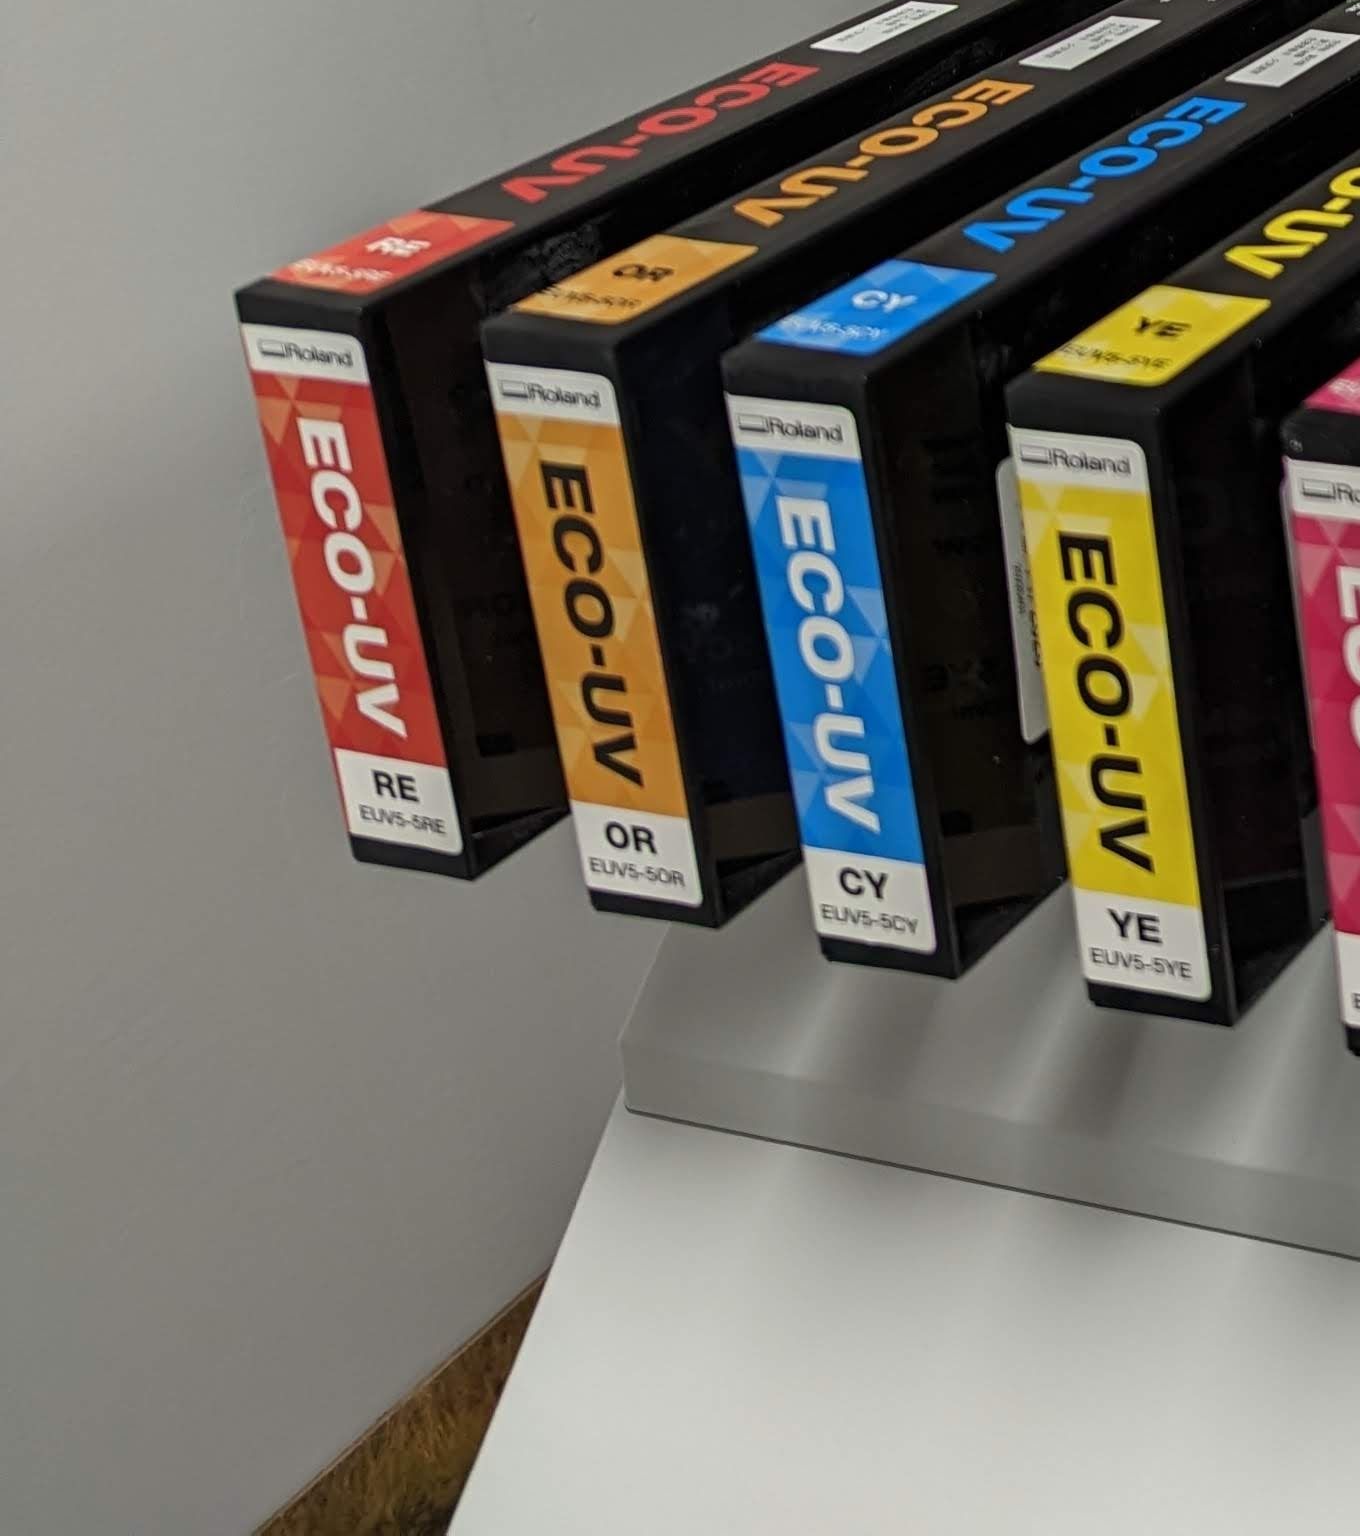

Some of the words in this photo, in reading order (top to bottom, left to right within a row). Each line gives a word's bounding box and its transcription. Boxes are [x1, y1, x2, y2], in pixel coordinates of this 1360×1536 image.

[502, 62, 821, 204] ECO-UV
[732, 78, 1035, 228] ECO-UV
[962, 96, 1247, 253] ECO-UV
[851, 290, 919, 314] CY
[1133, 315, 1193, 340] YE
[286, 341, 354, 369] Roland
[527, 381, 600, 409] Roland
[767, 416, 844, 443] Roland
[1053, 448, 1132, 477] Roland
[297, 417, 407, 739] ECO-UV
[538, 459, 645, 789] ECO-UV
[775, 495, 880, 834] ECO-UV
[1057, 529, 1157, 876] ECO-UV
[374, 773, 419, 803] RE
[359, 806, 446, 835] EUV5-5RE
[606, 824, 658, 855] OR
[588, 857, 686, 889] EUV5-5OR
[838, 869, 888, 901] CY
[820, 904, 919, 937] EUV5-5CY
[1108, 911, 1163, 945] YE
[1090, 946, 1193, 982] EUV5-5YE
